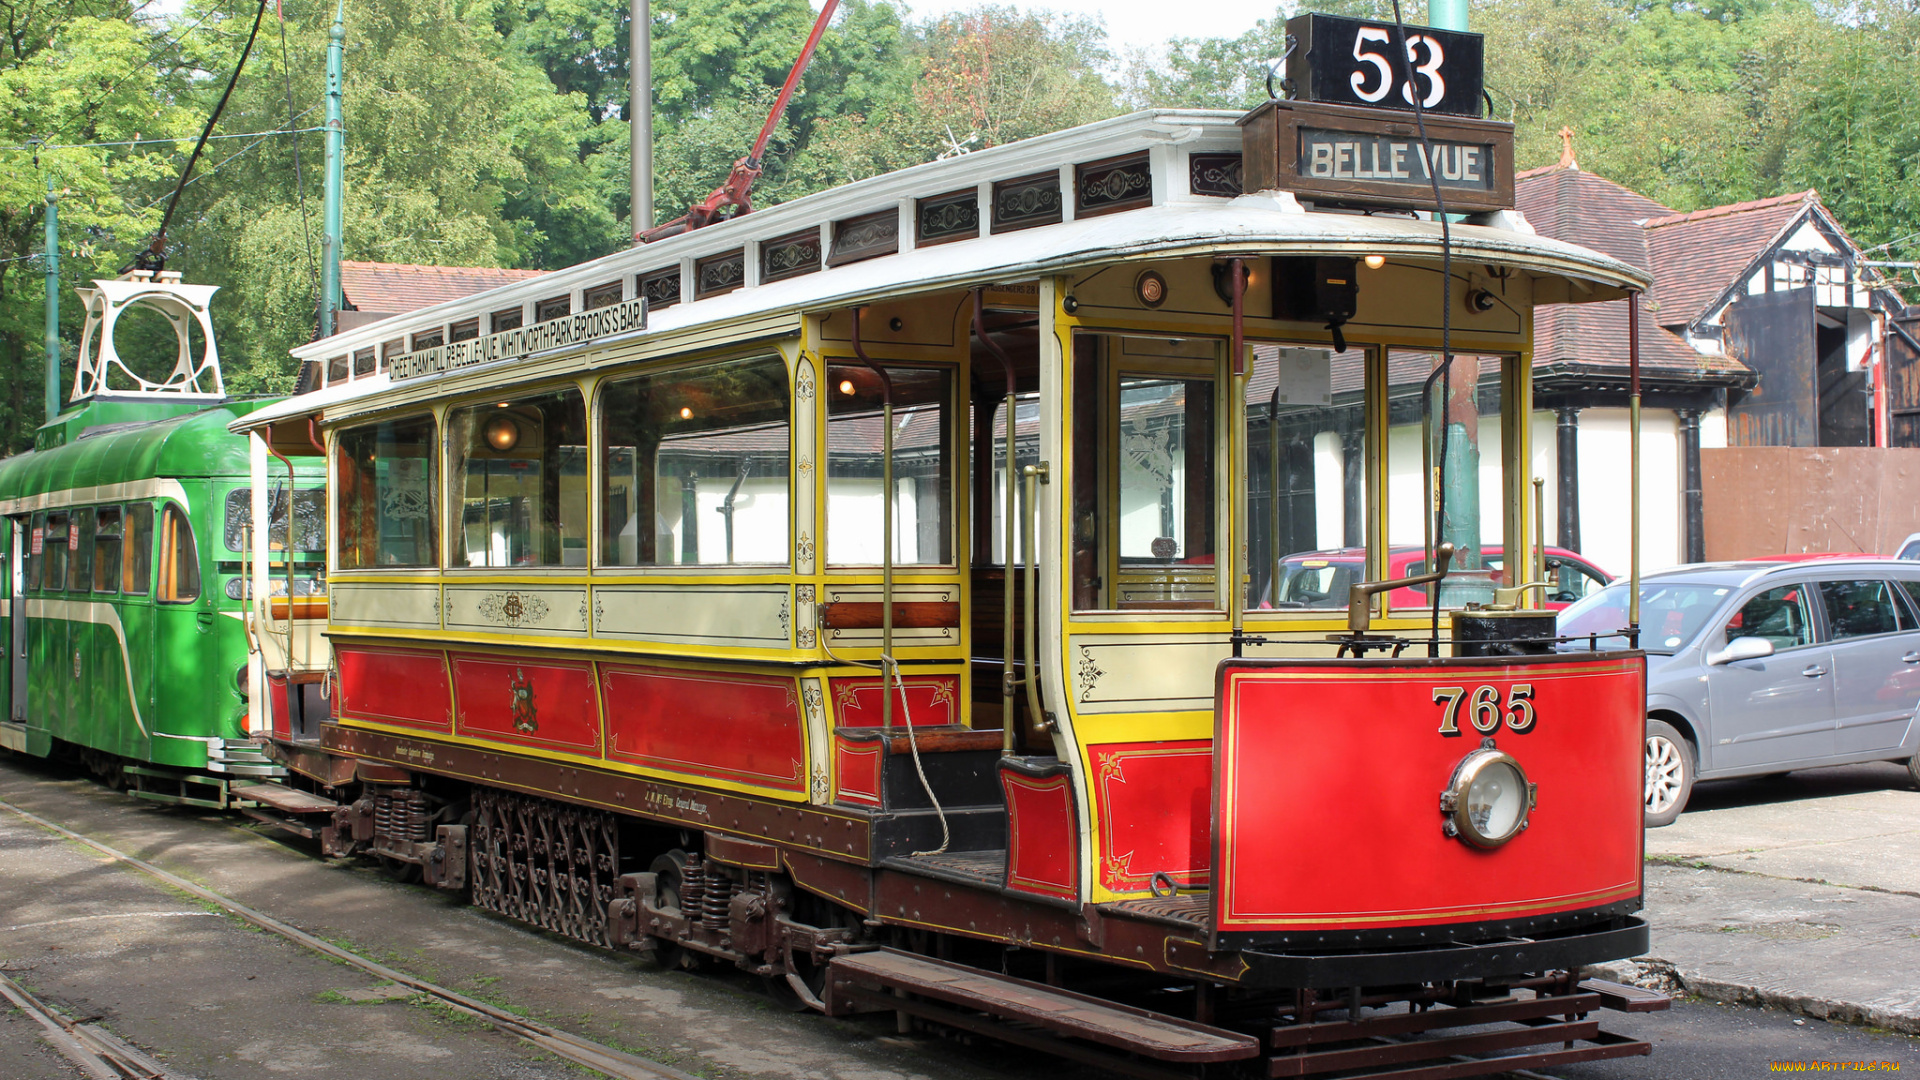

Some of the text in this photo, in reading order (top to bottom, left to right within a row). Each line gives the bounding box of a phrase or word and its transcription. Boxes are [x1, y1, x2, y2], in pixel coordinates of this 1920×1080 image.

[1350, 26, 1446, 109] 53
[1310, 142, 1480, 181] BELLE VUE
[389, 352, 429, 380] CHEETHAM
[430, 348, 445, 373] HILL
[500, 323, 549, 357] WHITWORTH
[574, 307, 619, 341] BROOKS'S
[620, 302, 642, 331] BAR.
[1432, 684, 1535, 735] 765
